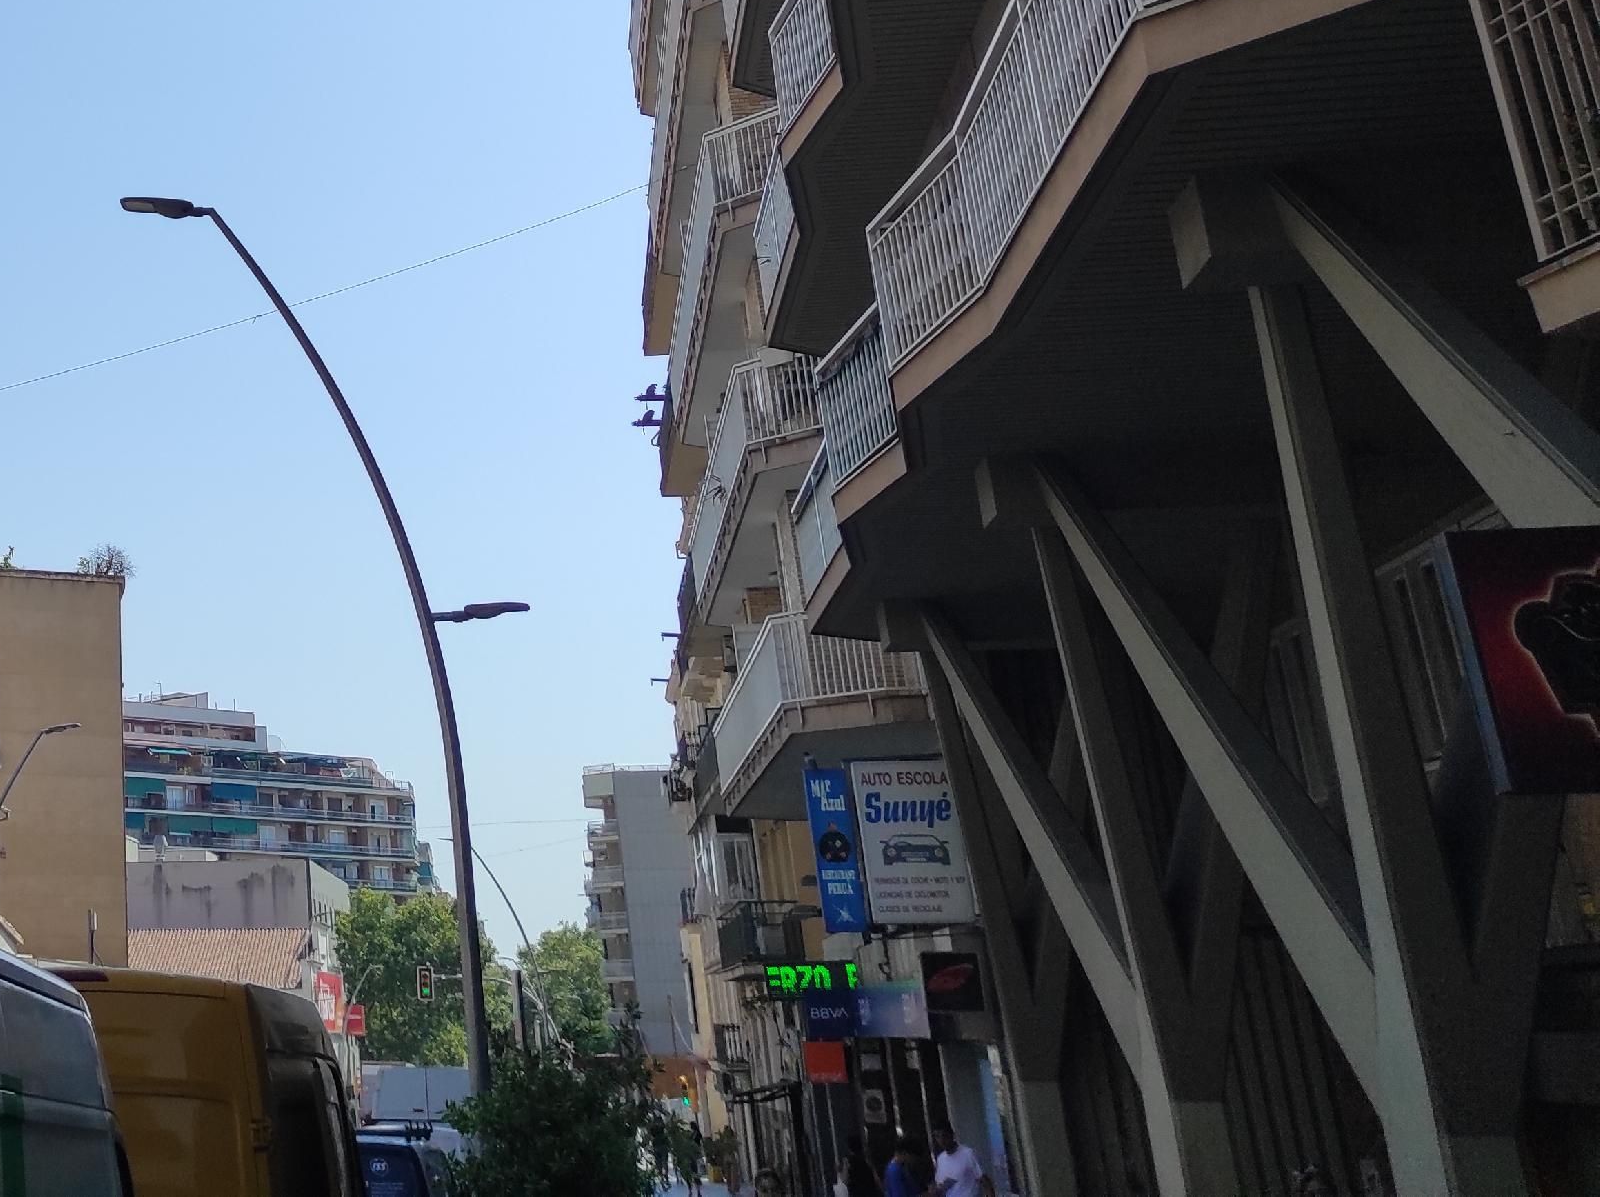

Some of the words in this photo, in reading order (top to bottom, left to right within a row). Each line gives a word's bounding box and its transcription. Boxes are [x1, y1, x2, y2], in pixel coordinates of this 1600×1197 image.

[861, 771, 892, 786] AUTO
[896, 771, 949, 785] ESCOLA
[864, 791, 952, 828] Sunyé
[810, 1007, 849, 1019] BBVA
